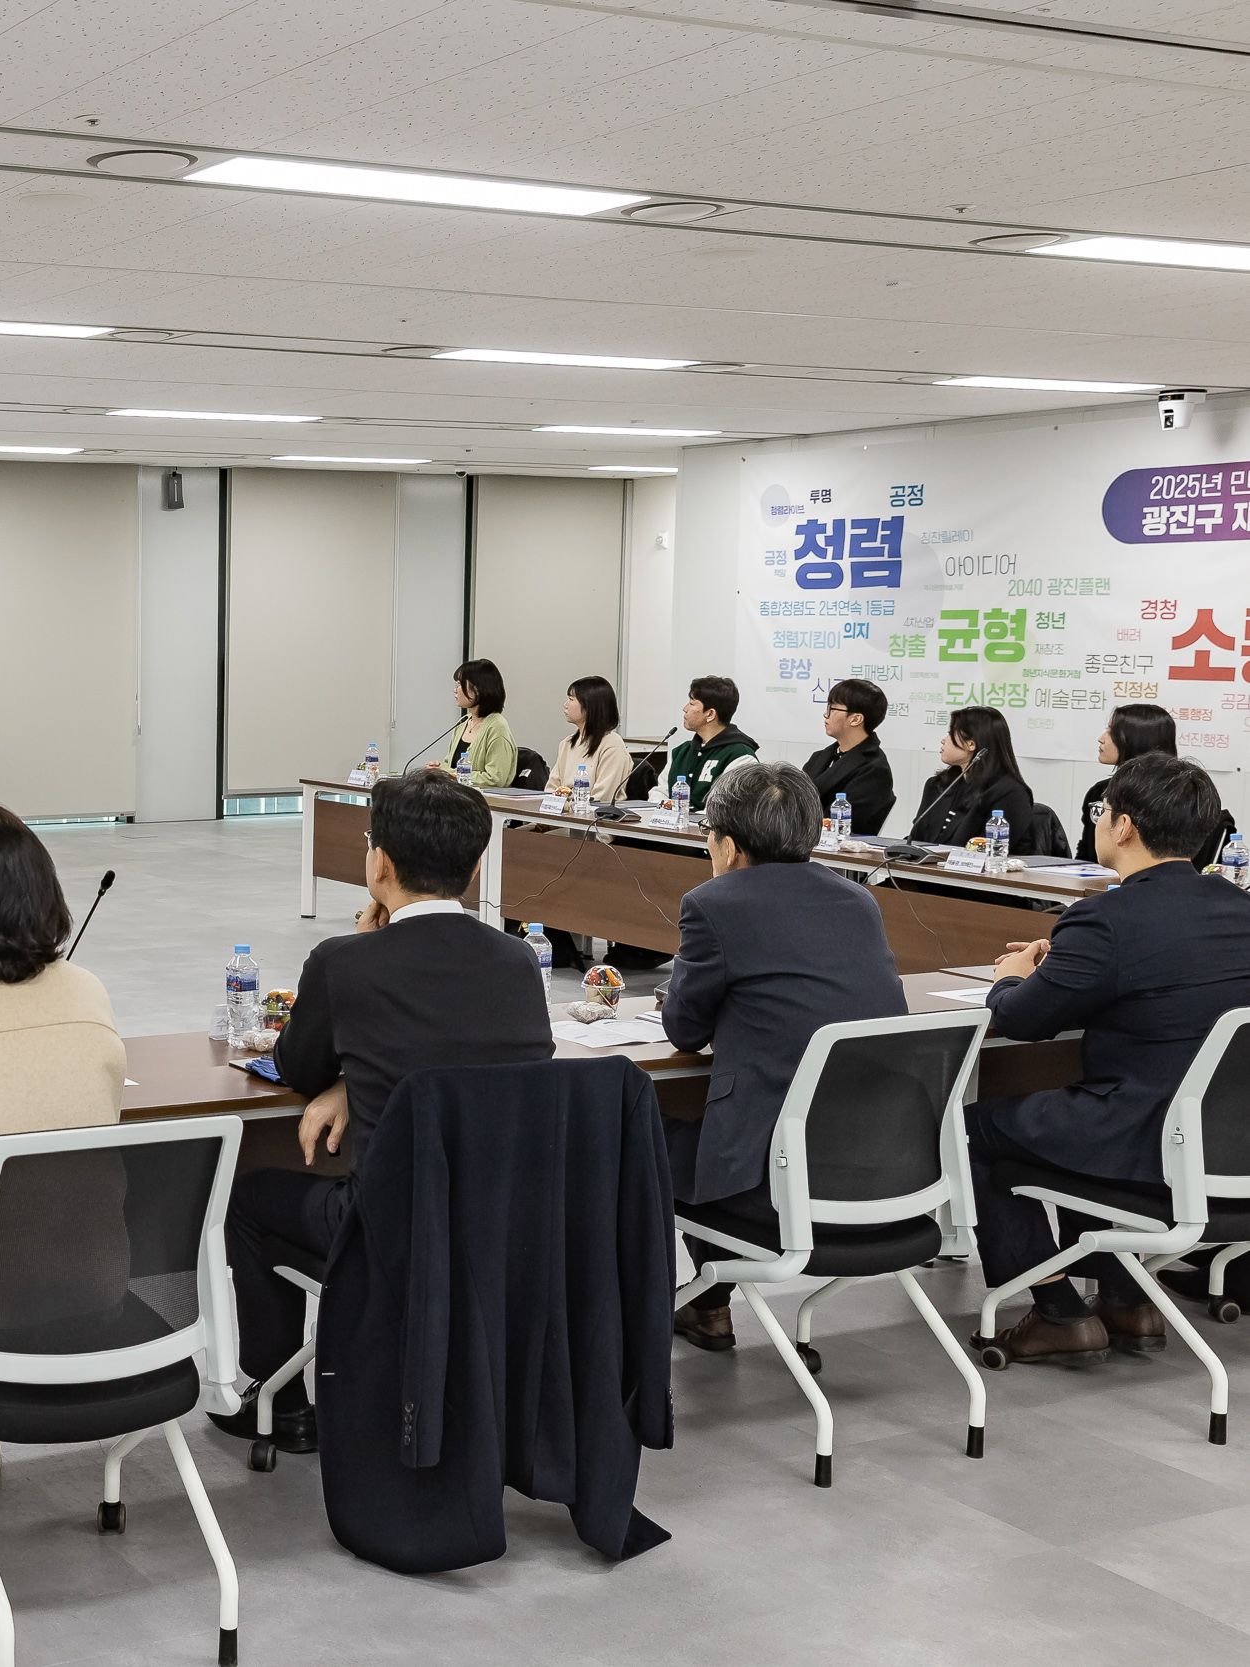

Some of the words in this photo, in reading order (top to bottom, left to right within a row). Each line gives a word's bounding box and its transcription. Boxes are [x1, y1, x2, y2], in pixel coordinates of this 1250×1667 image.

[810, 489, 832, 504] 투명
[889, 484, 924, 507] 공정
[1150, 472, 1223, 500] 2025년
[770, 505, 805, 516] 청렴라이브
[1141, 503, 1224, 536] 광진구
[764, 550, 787, 566] 긍정
[794, 515, 904, 590] 청렴
[945, 554, 1017, 577] 아이디어
[1008, 578, 1043, 597] 2040
[1047, 577, 1111, 596] 광진플랜
[759, 600, 816, 617] 종합청렴도
[819, 600, 862, 616] 2년연속
[866, 599, 895, 616] 1등급
[1141, 599, 1178, 620] 경청
[843, 622, 870, 639] 의지
[1035, 611, 1066, 630] 청년
[772, 630, 841, 649] 청렴지킴이
[889, 633, 926, 658] 창출
[938, 608, 1027, 663] 균형
[1116, 628, 1142, 642] 배려
[1168, 607, 1250, 684] 소
[779, 658, 812, 680] 향상
[850, 664, 903, 682] 부패방지
[1085, 654, 1154, 675] 좋은친구
[812, 678, 847, 703] 신
[945, 681, 1029, 708] 도시성장
[1034, 688, 1107, 710] 예술문화
[1113, 681, 1159, 699] 진정성
[1162, 707, 1213, 722] 소통행정
[698, 760, 719, 782] K
